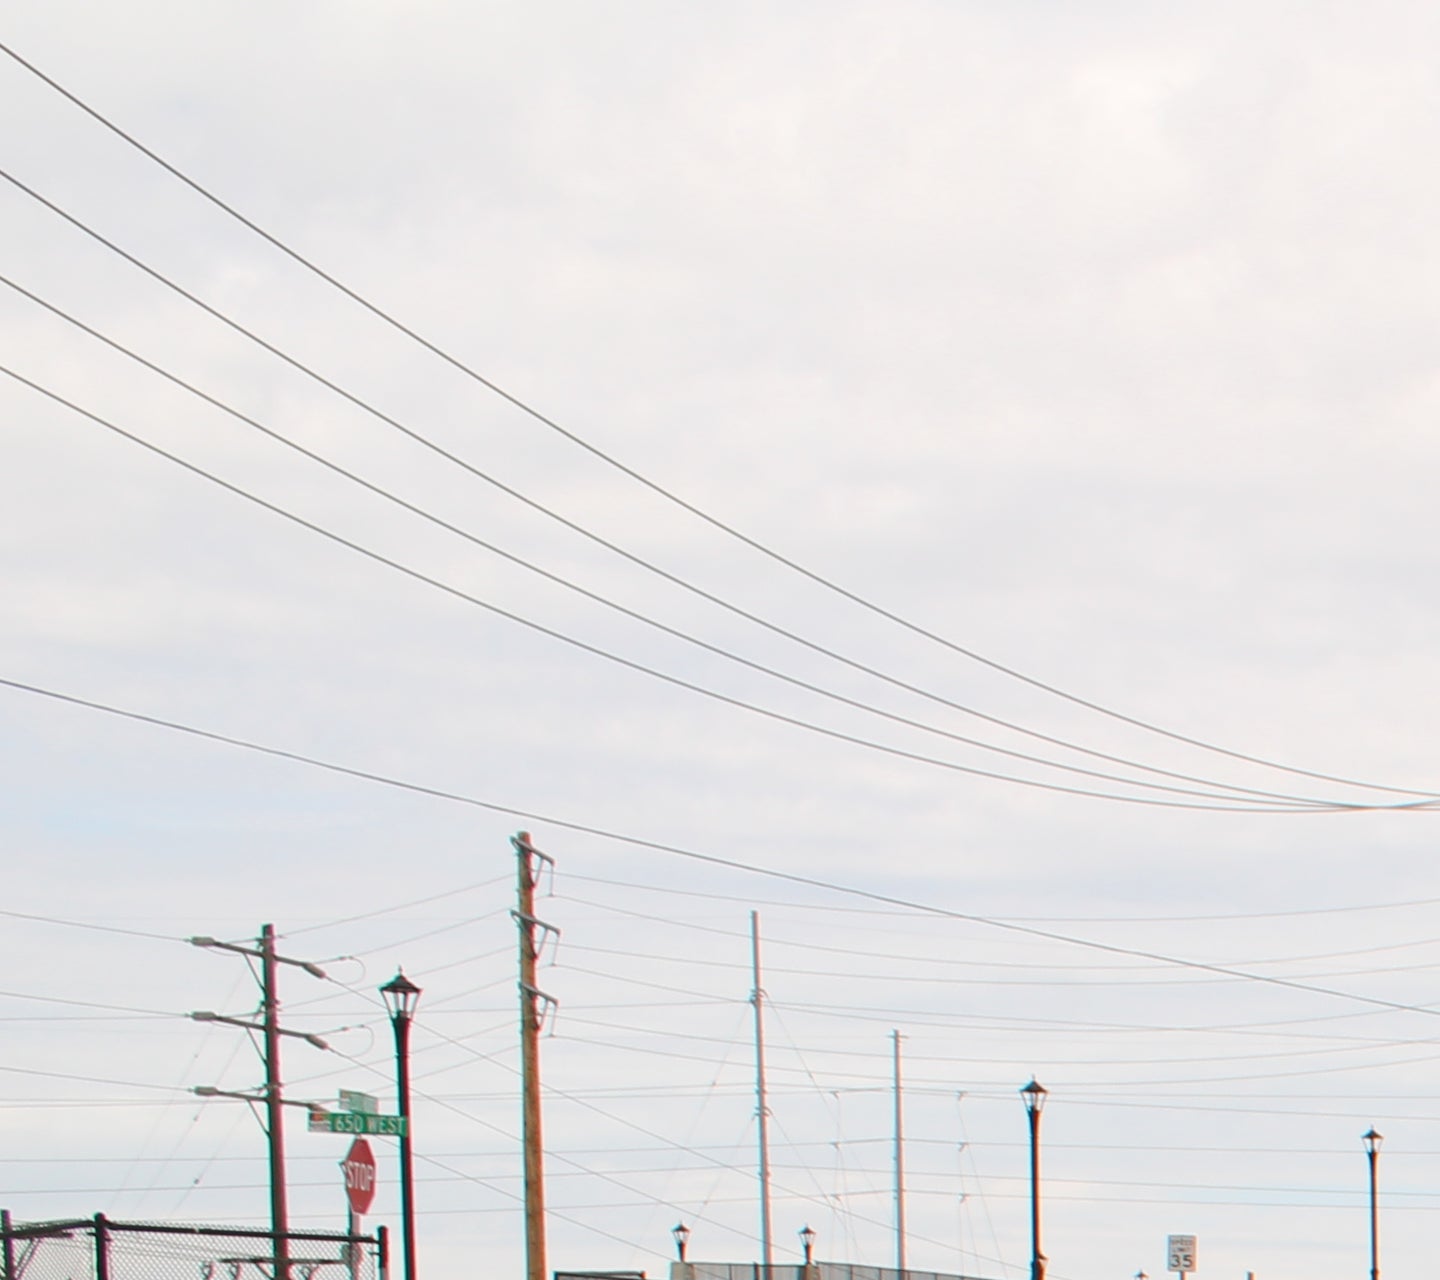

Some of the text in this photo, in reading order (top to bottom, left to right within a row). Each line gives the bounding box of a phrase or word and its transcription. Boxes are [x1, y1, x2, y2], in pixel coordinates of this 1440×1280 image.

[335, 1114, 405, 1134] 650 WEST
[347, 1161, 374, 1191] STOP
[1171, 1254, 1193, 1268] 35
